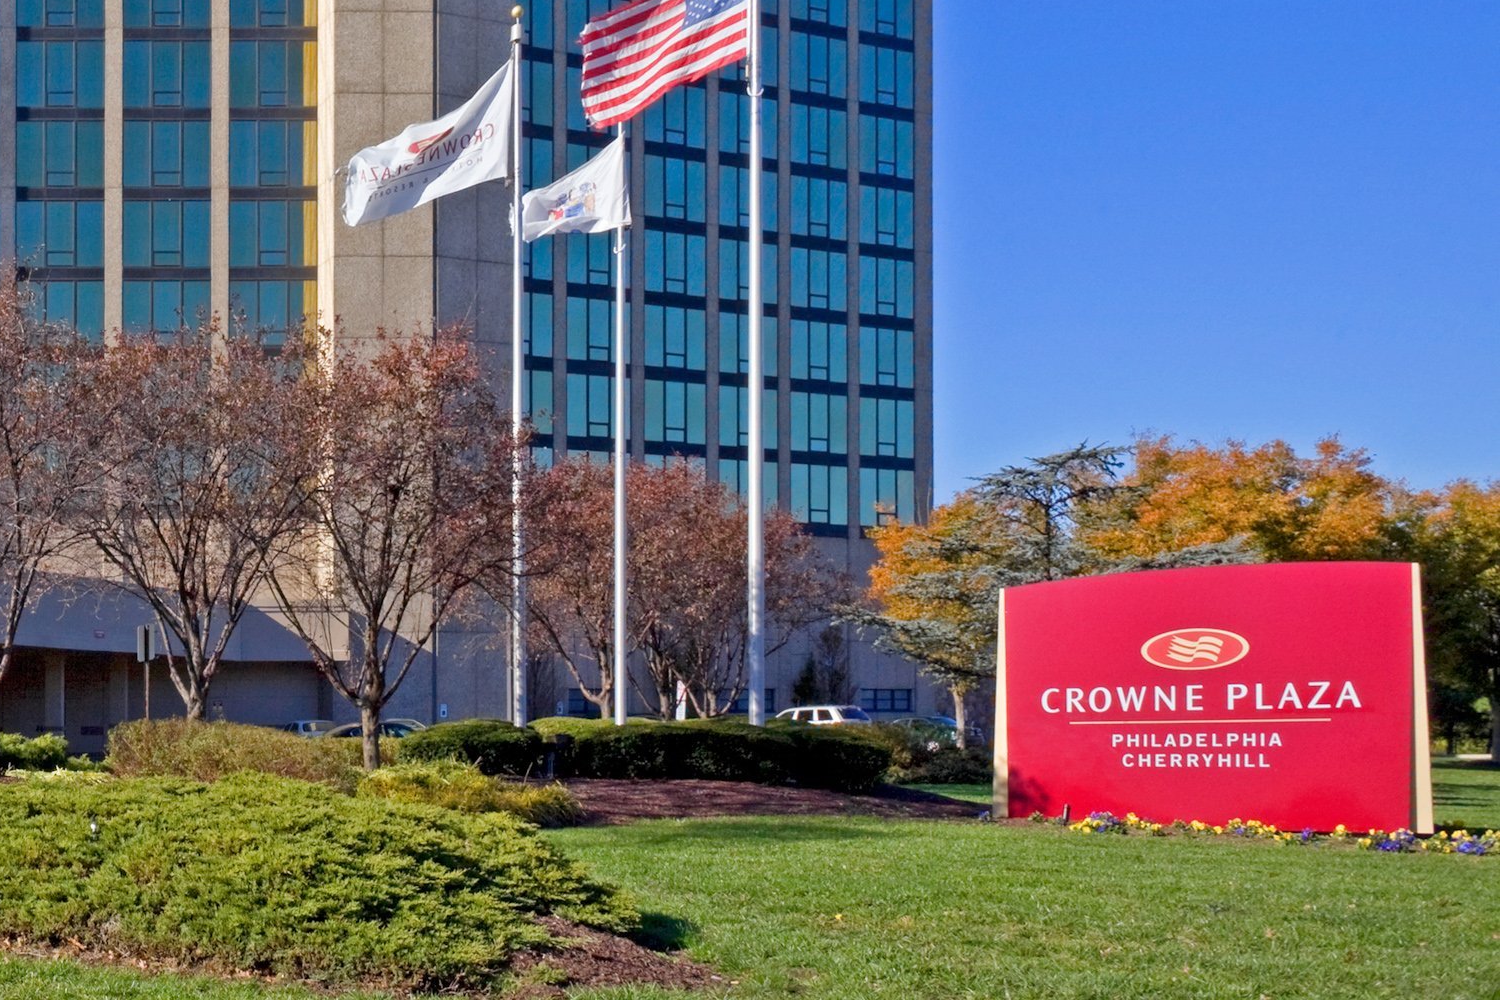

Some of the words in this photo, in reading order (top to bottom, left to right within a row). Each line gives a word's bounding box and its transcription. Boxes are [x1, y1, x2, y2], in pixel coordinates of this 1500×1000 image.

[1040, 684, 1204, 713] CROWNE
[1227, 681, 1363, 710] PLAZA
[1111, 732, 1283, 748] PHILADELPHIA
[1121, 752, 1271, 768] CHERRYHILL
